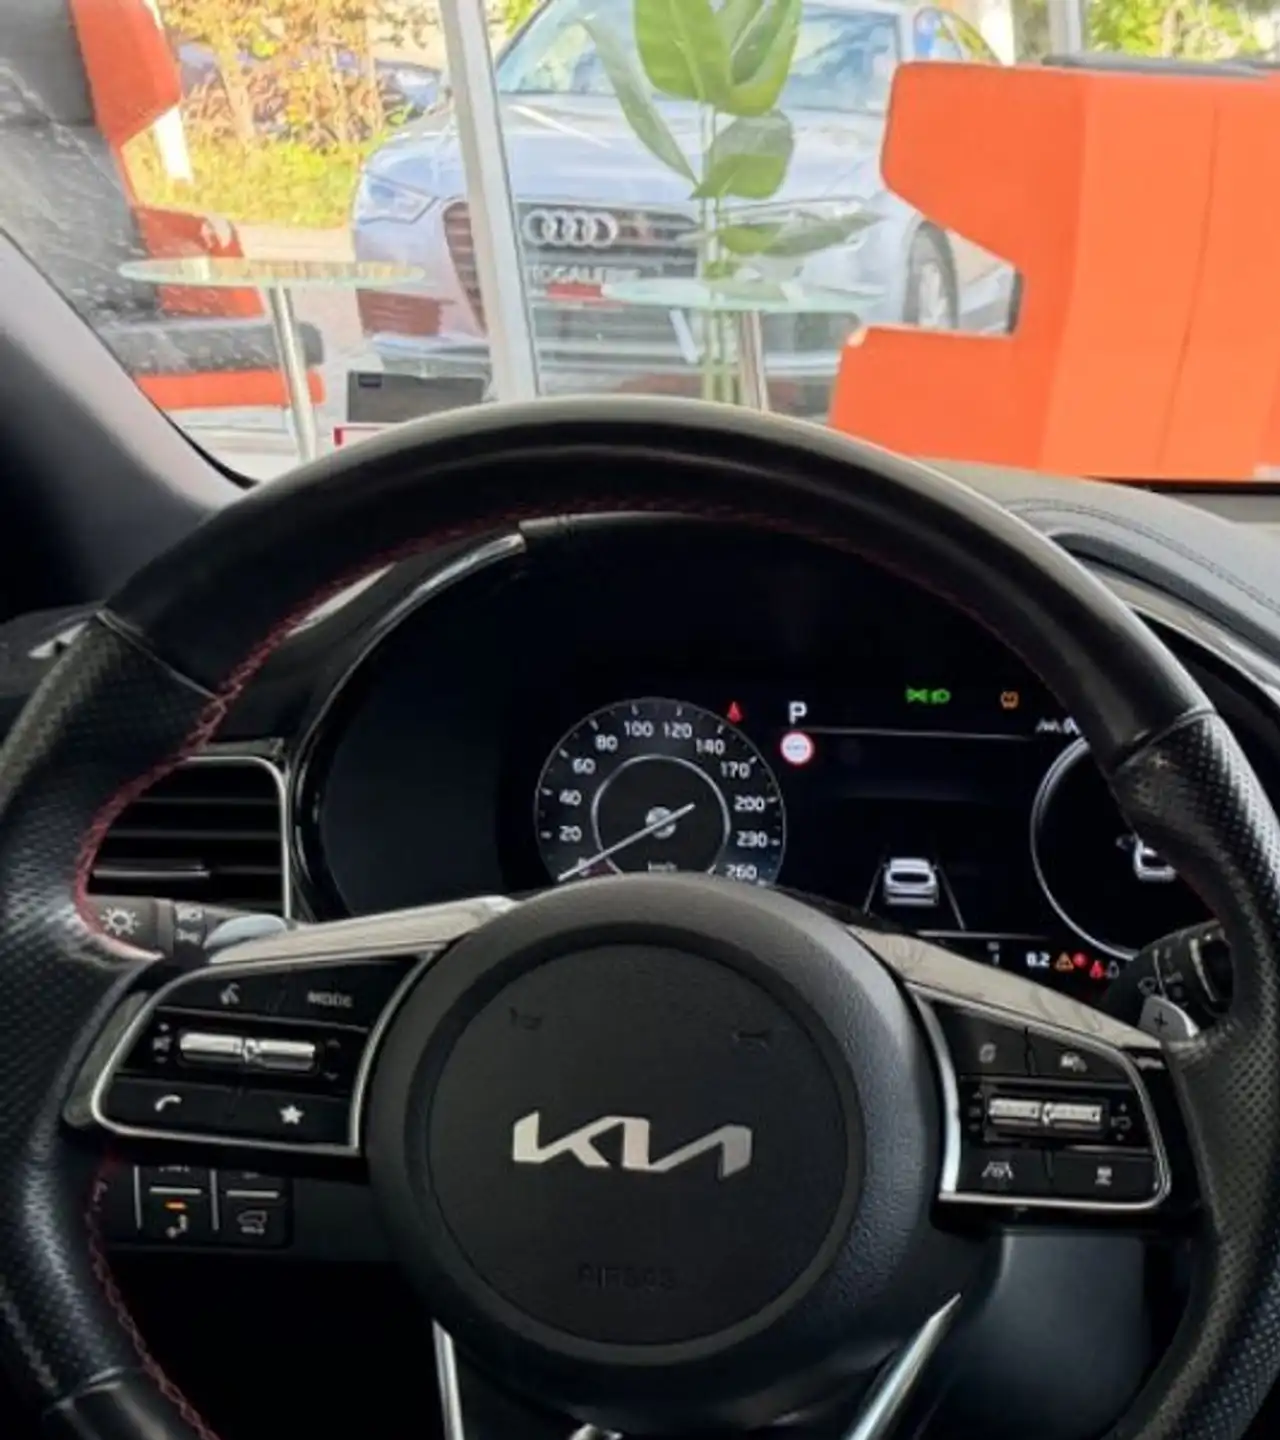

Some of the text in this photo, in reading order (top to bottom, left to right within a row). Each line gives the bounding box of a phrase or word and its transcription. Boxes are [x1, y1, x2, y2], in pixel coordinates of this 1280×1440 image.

[788, 701, 807, 724] P
[623, 720, 654, 738] 100
[662, 720, 693, 739] 120
[594, 734, 618, 751] 80
[695, 738, 725, 755] 140
[572, 757, 596, 774] 60
[720, 760, 750, 779] 170
[558, 789, 582, 806] 40
[734, 795, 766, 812] 200
[558, 825, 582, 842] 20
[736, 830, 768, 848] 230
[725, 863, 758, 880] 260
[307, 990, 353, 1008] MODE
